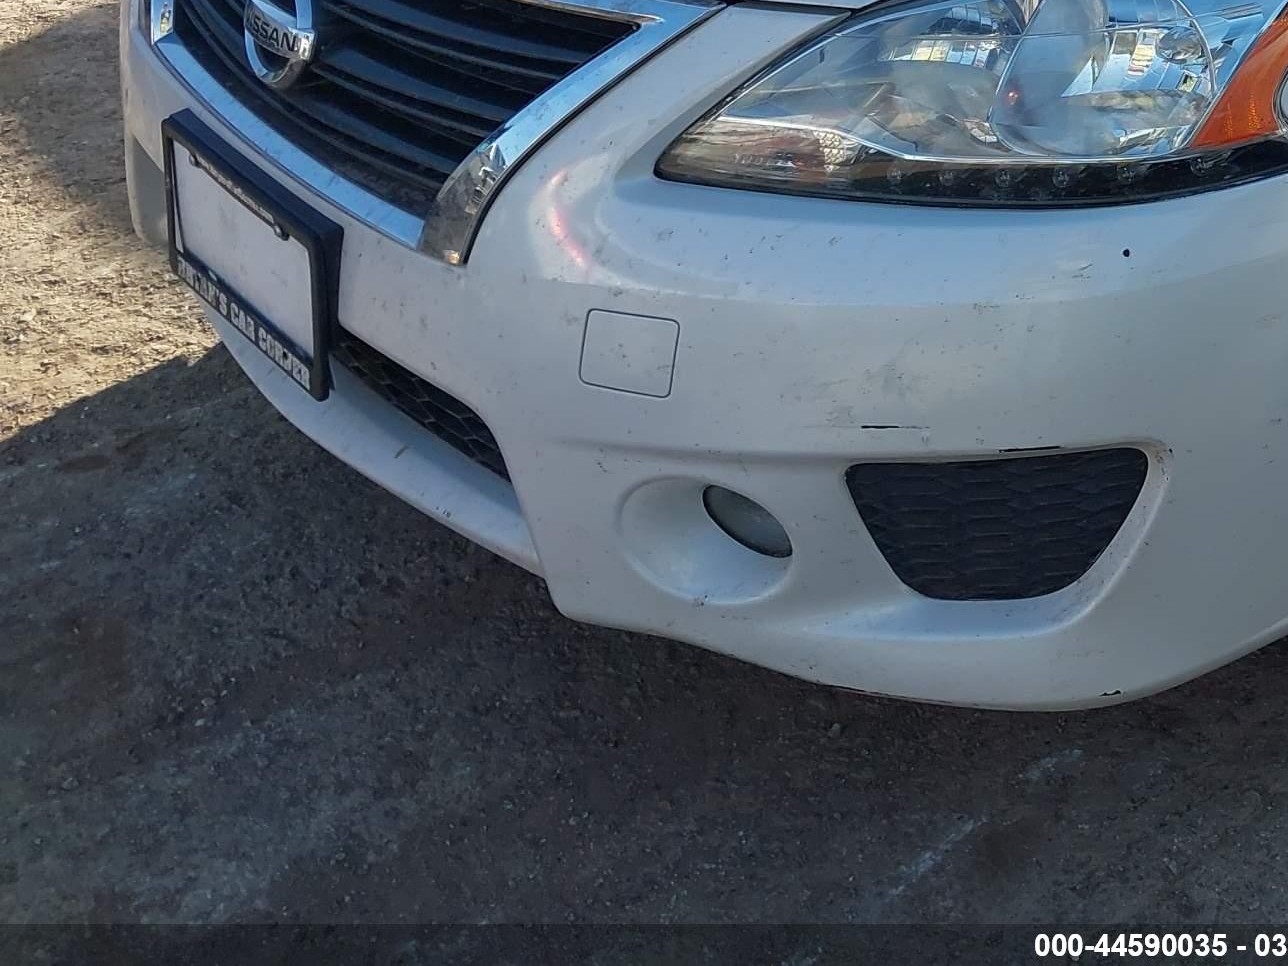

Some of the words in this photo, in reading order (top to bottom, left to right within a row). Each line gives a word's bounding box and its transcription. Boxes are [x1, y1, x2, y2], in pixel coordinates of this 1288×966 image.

[246, 8, 297, 52] NISSAN
[231, 302, 256, 342] CAR
[258, 327, 311, 391] CORNER
